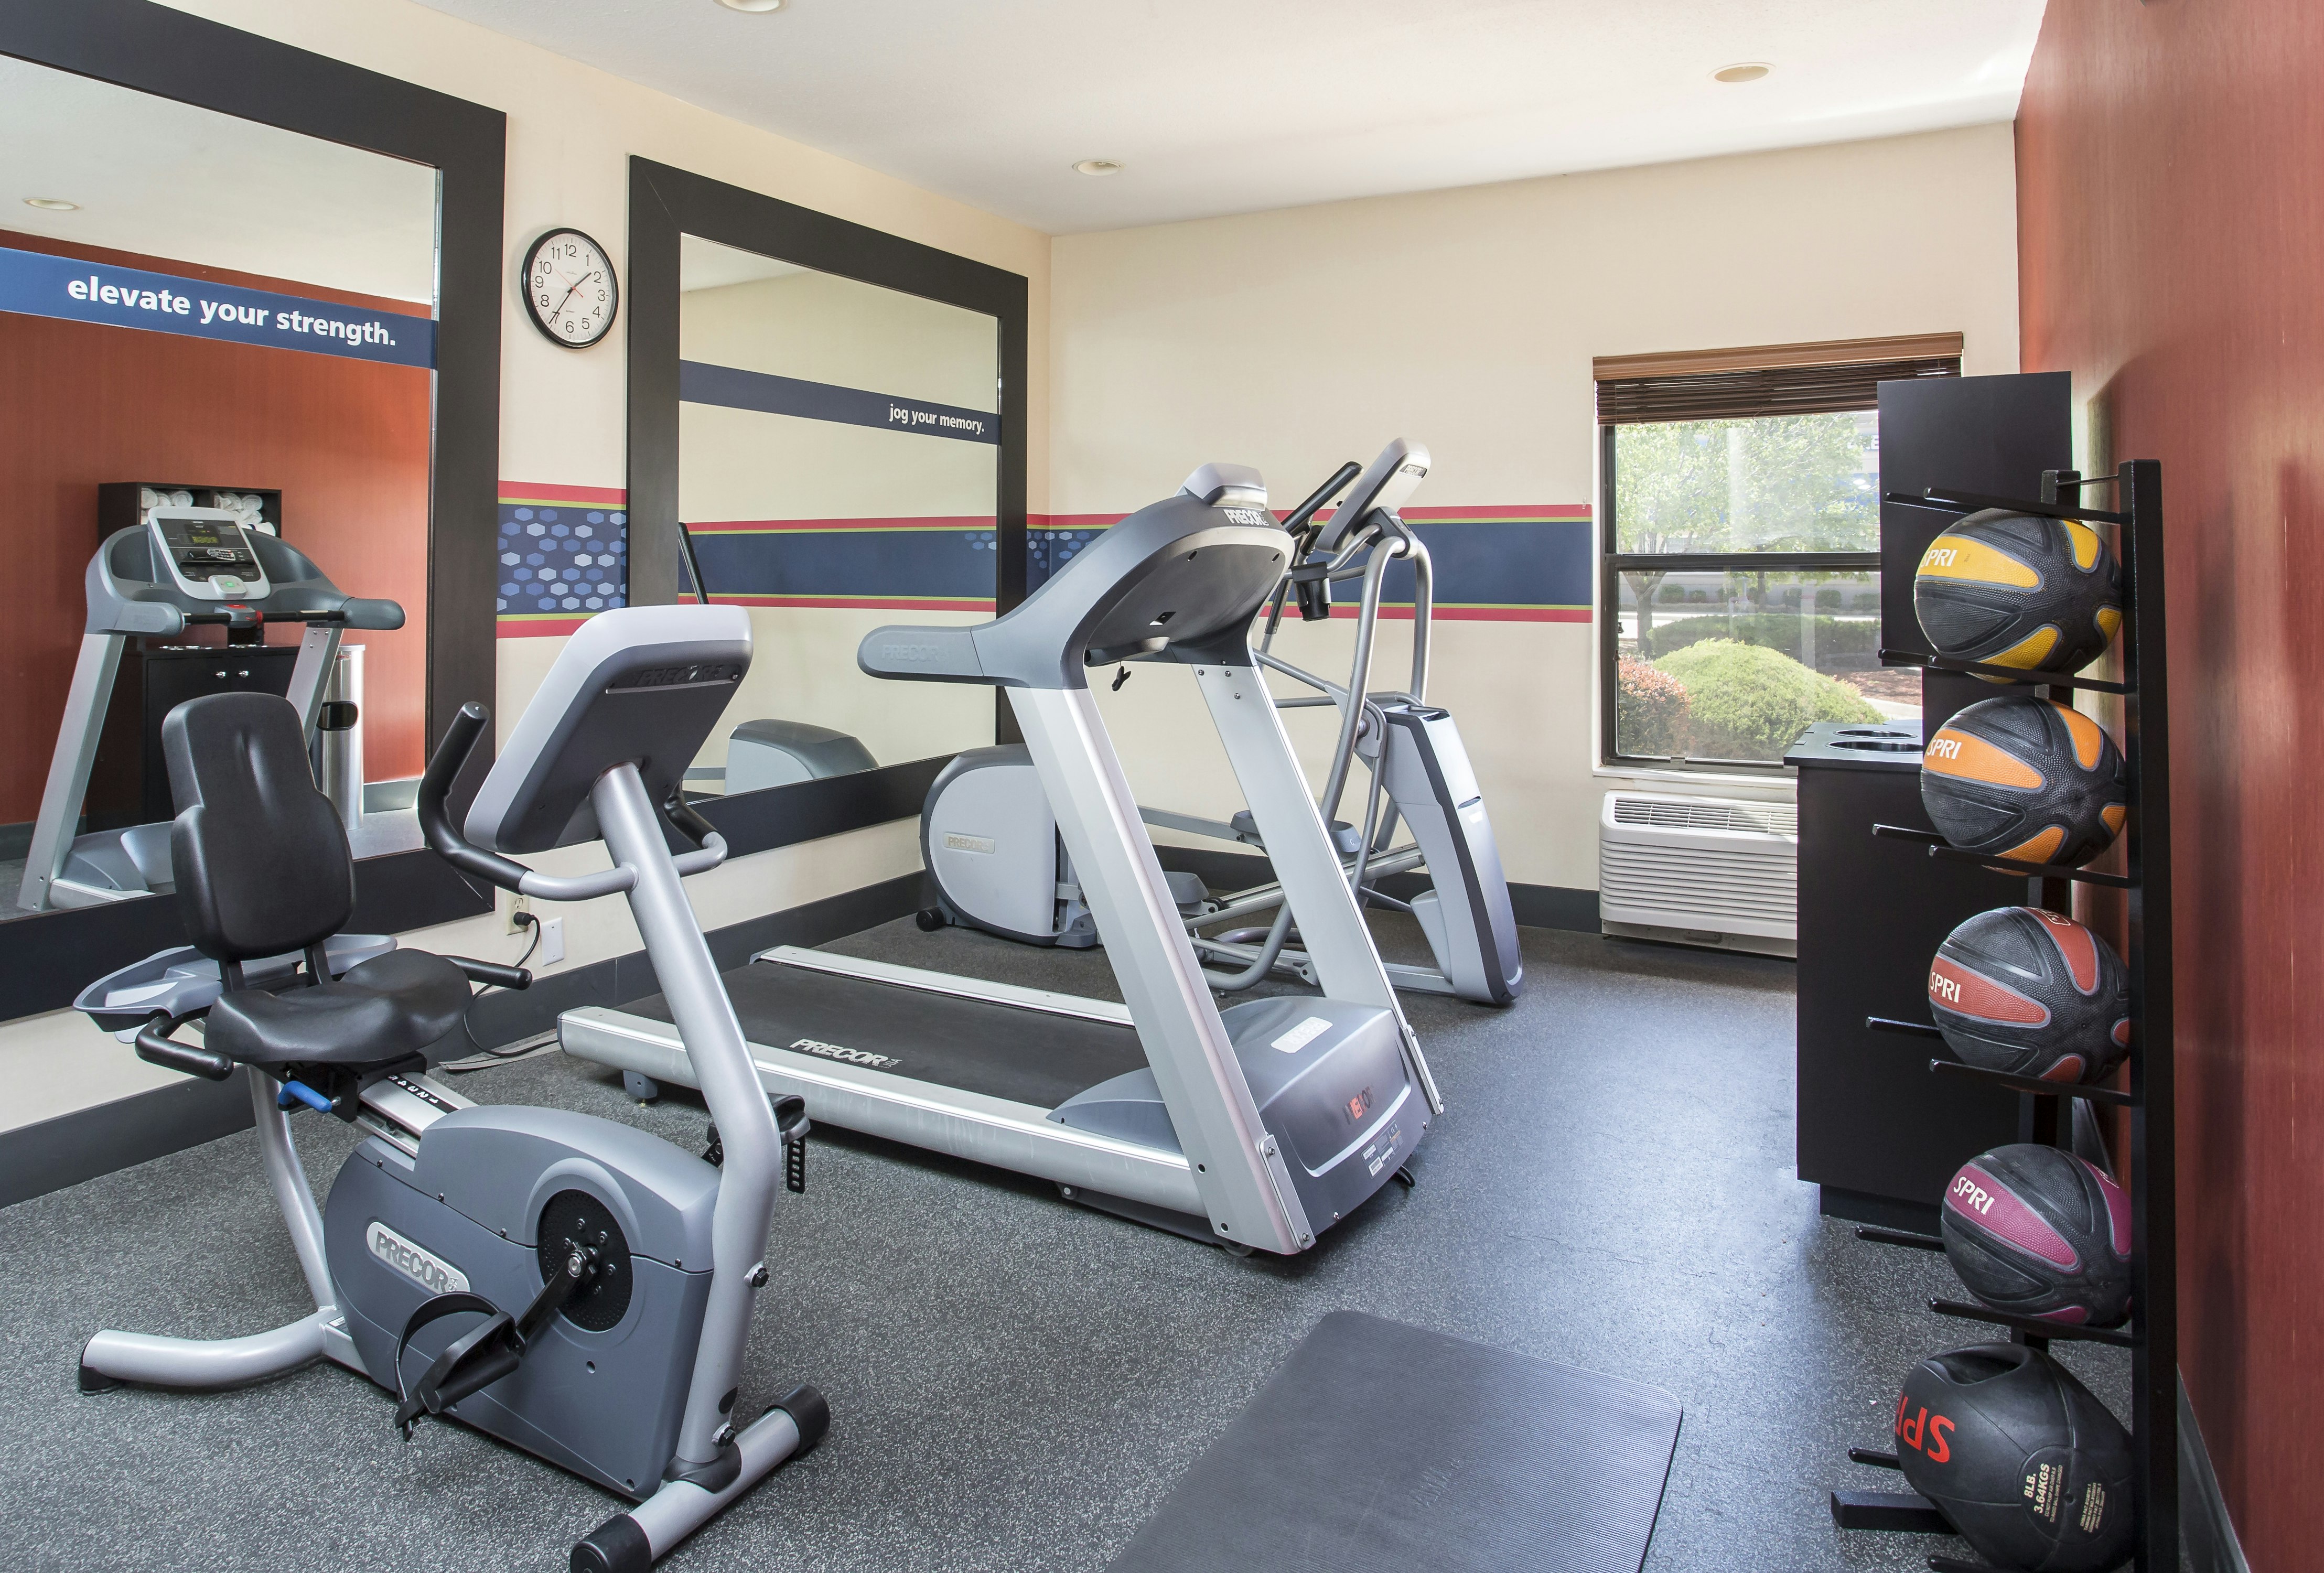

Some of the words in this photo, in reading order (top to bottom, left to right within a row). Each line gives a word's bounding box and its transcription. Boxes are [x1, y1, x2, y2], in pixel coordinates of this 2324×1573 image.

[551, 246, 560, 260] 11
[564, 243, 577, 257] 12
[539, 260, 552, 274] 10
[586, 254, 589, 266] 1
[535, 275, 544, 288] 9
[594, 271, 601, 284] 2
[540, 294, 550, 307] 8
[597, 289, 606, 301] 3
[68, 276, 190, 315] elevate
[199, 299, 269, 326] your
[276, 310, 396, 346] strength.
[552, 311, 560, 324] 7
[592, 306, 600, 318] 4
[565, 321, 574, 333] 6
[582, 317, 590, 330] 5
[889, 403, 908, 424] jog
[911, 410, 937, 425] your
[940, 415, 984, 435] memory.
[1223, 509, 1264, 525] PRECOR
[881, 644, 939, 662] PRECOR
[1927, 738, 1962, 760] SPRI
[1930, 972, 1961, 1003] SPRI
[789, 1038, 888, 1066] PRECOR
[1953, 1176, 1995, 1215] SPRI
[375, 1231, 448, 1292] PRECOR
[448, 1278, 458, 1292] SA
[2024, 1473, 2037, 1498] 8LB.
[2034, 1463, 2050, 1514] 3.64KGS
